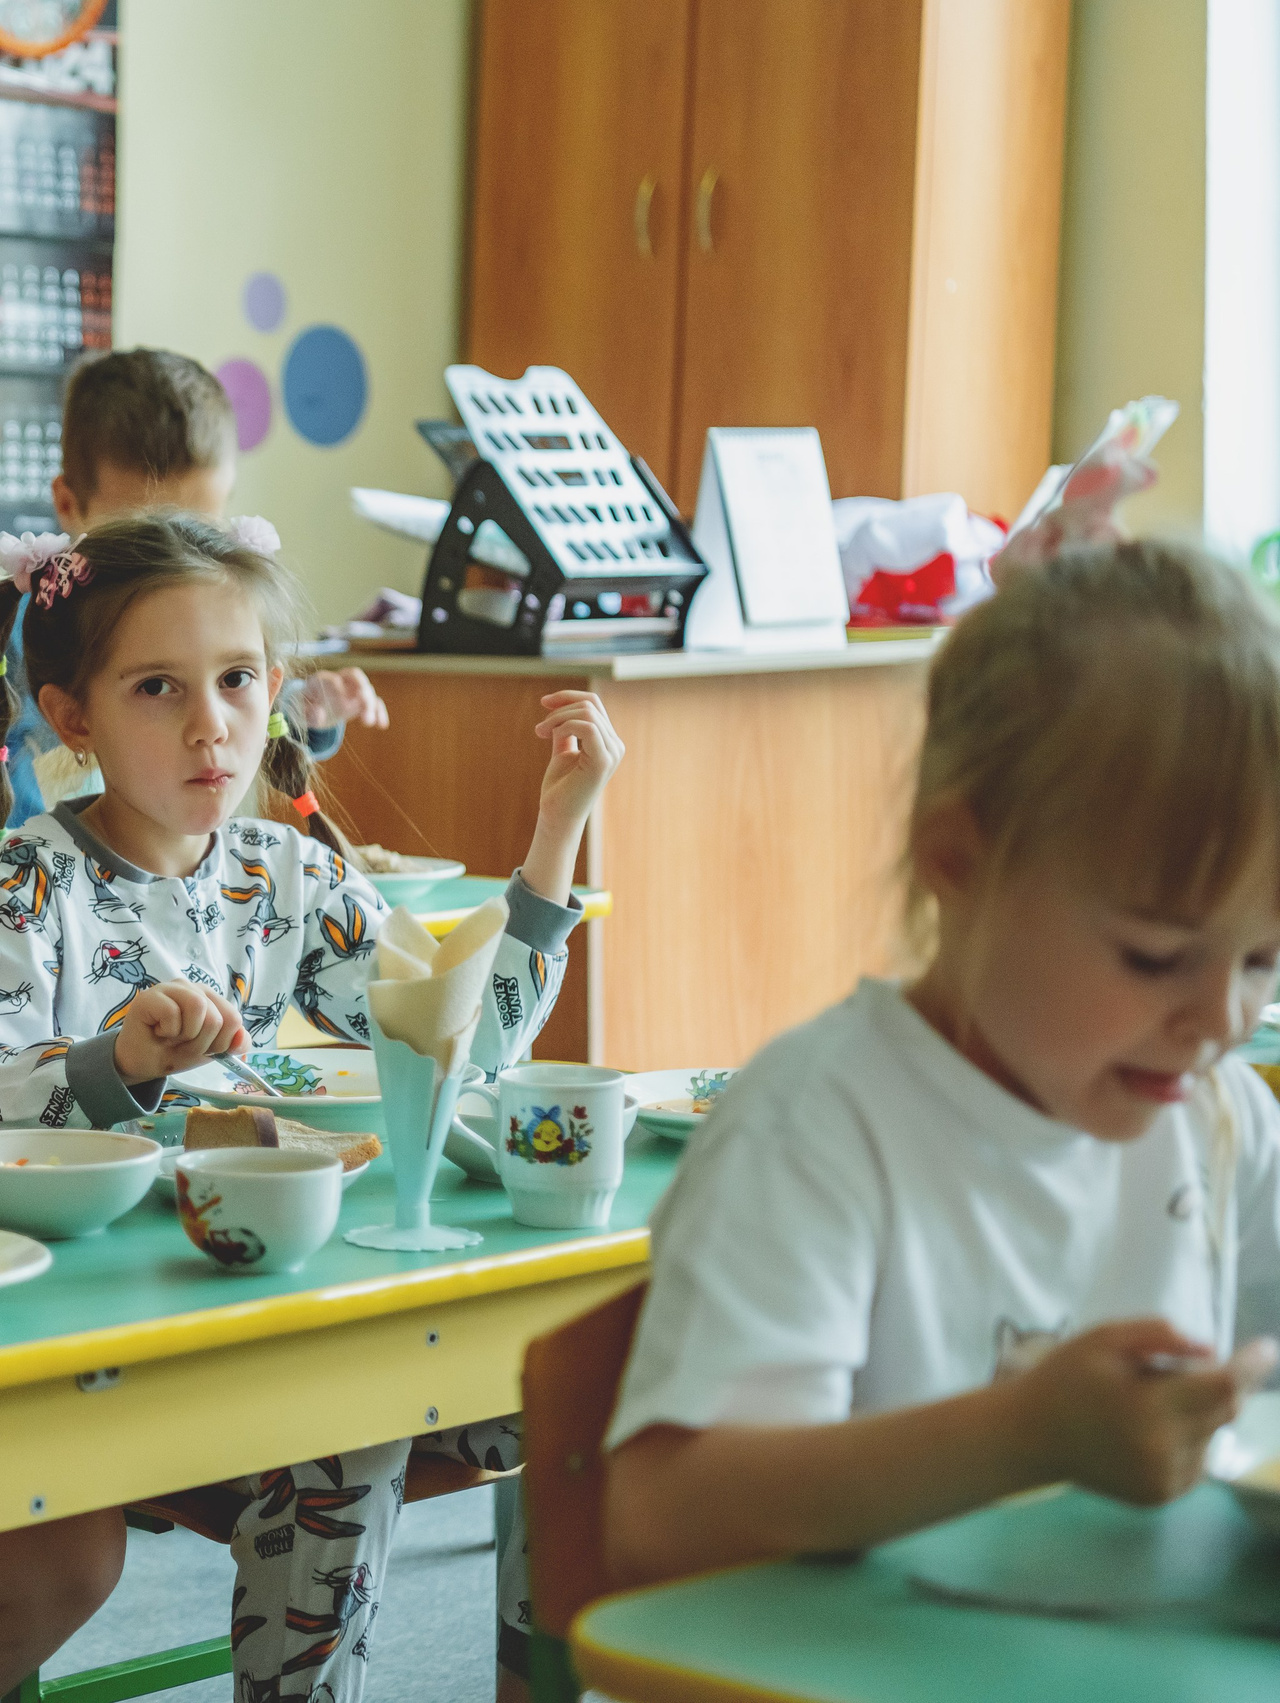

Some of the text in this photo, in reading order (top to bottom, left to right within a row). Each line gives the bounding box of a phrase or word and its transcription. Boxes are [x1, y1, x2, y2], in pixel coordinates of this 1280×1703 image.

[61, 853, 76, 896] LOONE
[493, 973, 513, 1029] LOONEY
[506, 977, 523, 1025] TUNES
[39, 1085, 66, 1126] TUNES
[55, 1087, 74, 1128] OONE
